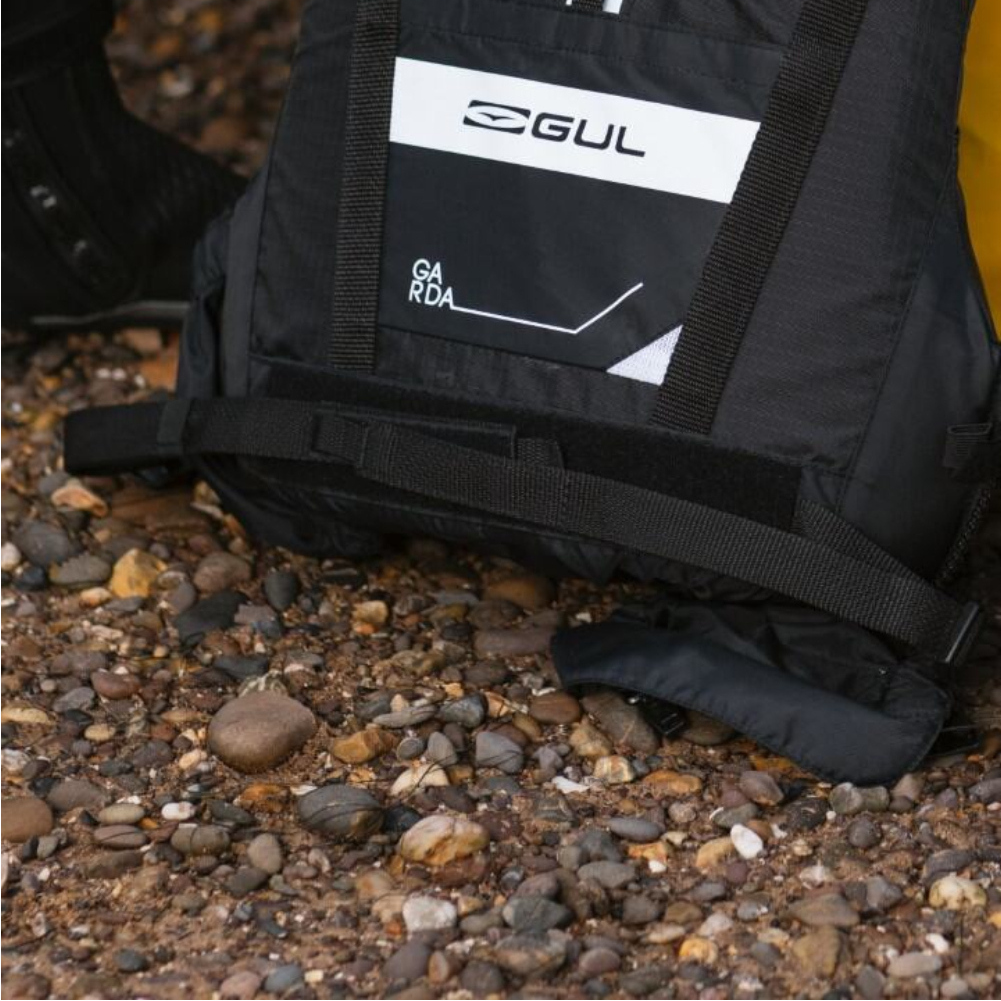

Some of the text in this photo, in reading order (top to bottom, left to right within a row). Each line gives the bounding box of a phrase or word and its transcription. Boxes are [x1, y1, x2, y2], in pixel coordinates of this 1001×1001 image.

[531, 111, 646, 158] GUL
[411, 258, 443, 285] GA
[408, 279, 455, 309] RDA
